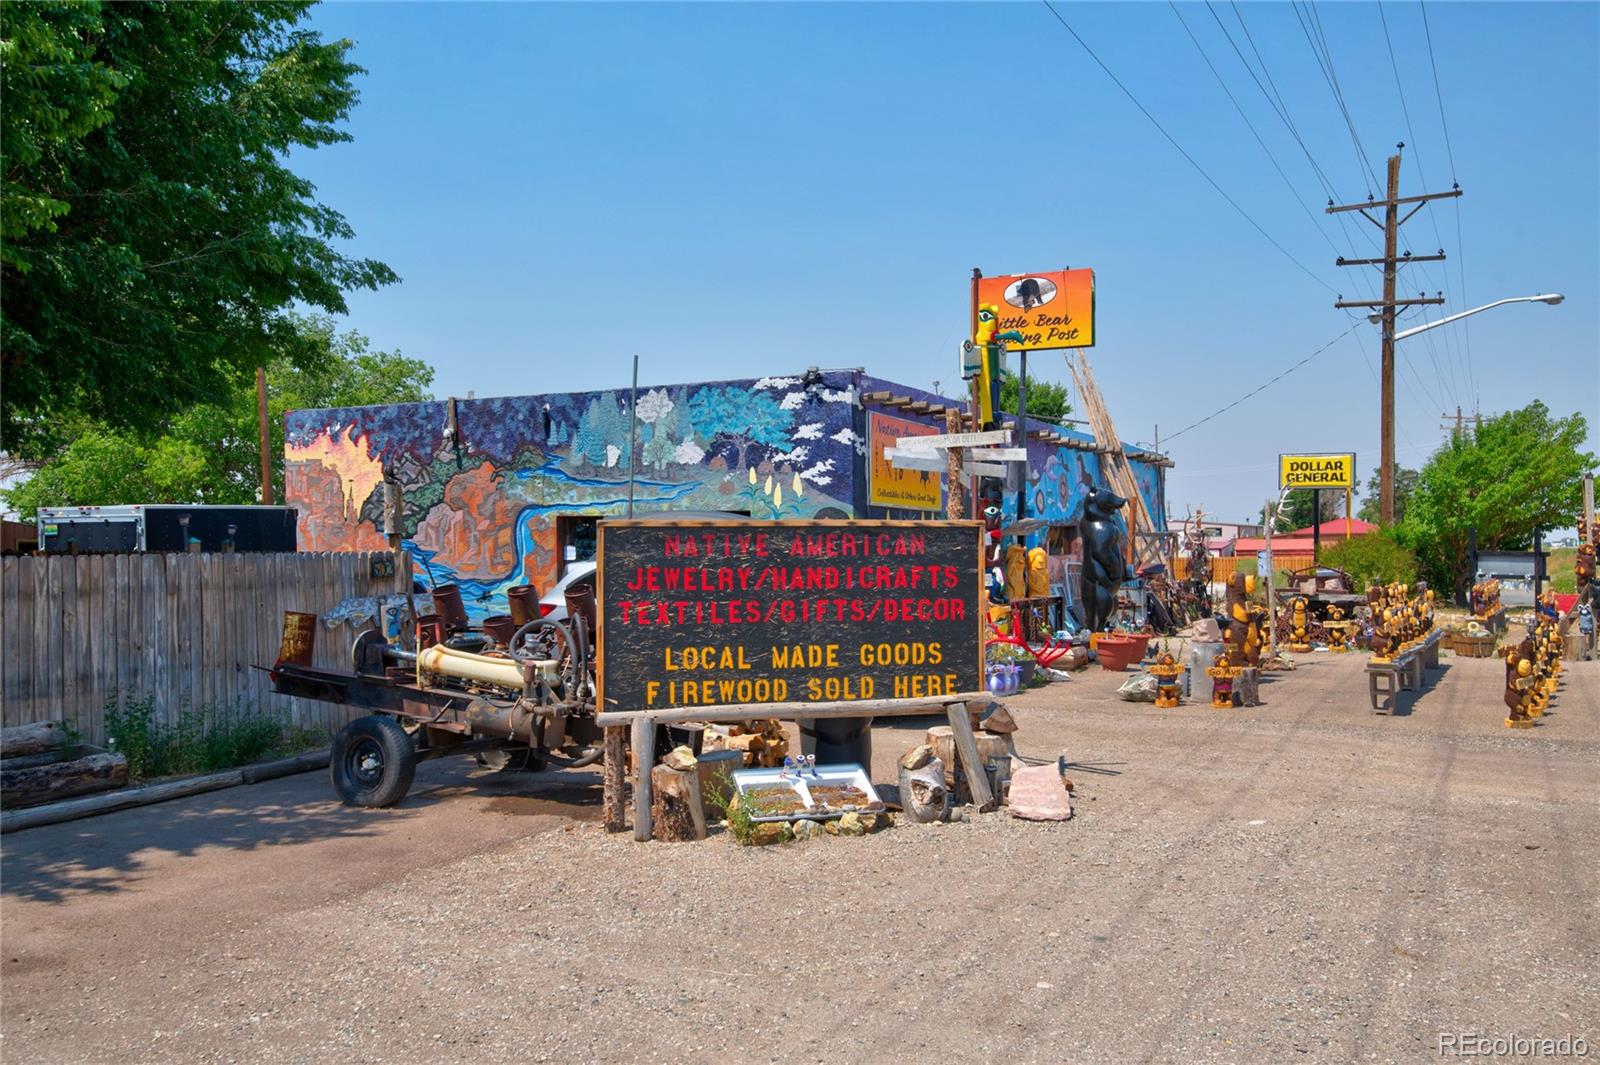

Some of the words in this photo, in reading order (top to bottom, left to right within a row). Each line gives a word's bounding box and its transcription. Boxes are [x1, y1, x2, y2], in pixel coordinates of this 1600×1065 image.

[998, 316, 1030, 329] ittle
[1034, 313, 1072, 327] Bear
[1047, 328, 1079, 341] Post
[1286, 472, 1347, 482] GENERAL
[1290, 460, 1343, 471] DOLLAR
[664, 533, 769, 558] NATIVE
[790, 533, 925, 557] AMERICAN
[626, 565, 960, 592] JEWELRY/HANDICRAFTS
[617, 598, 966, 626] TEXTILES/GIFTS/DECOR
[665, 646, 752, 671] LOCAL
[772, 644, 840, 669] MADE
[860, 642, 943, 665] GOODS
[646, 678, 788, 705] FIREWOOD
[807, 676, 875, 701] SOLD
[894, 674, 958, 698] HERE
